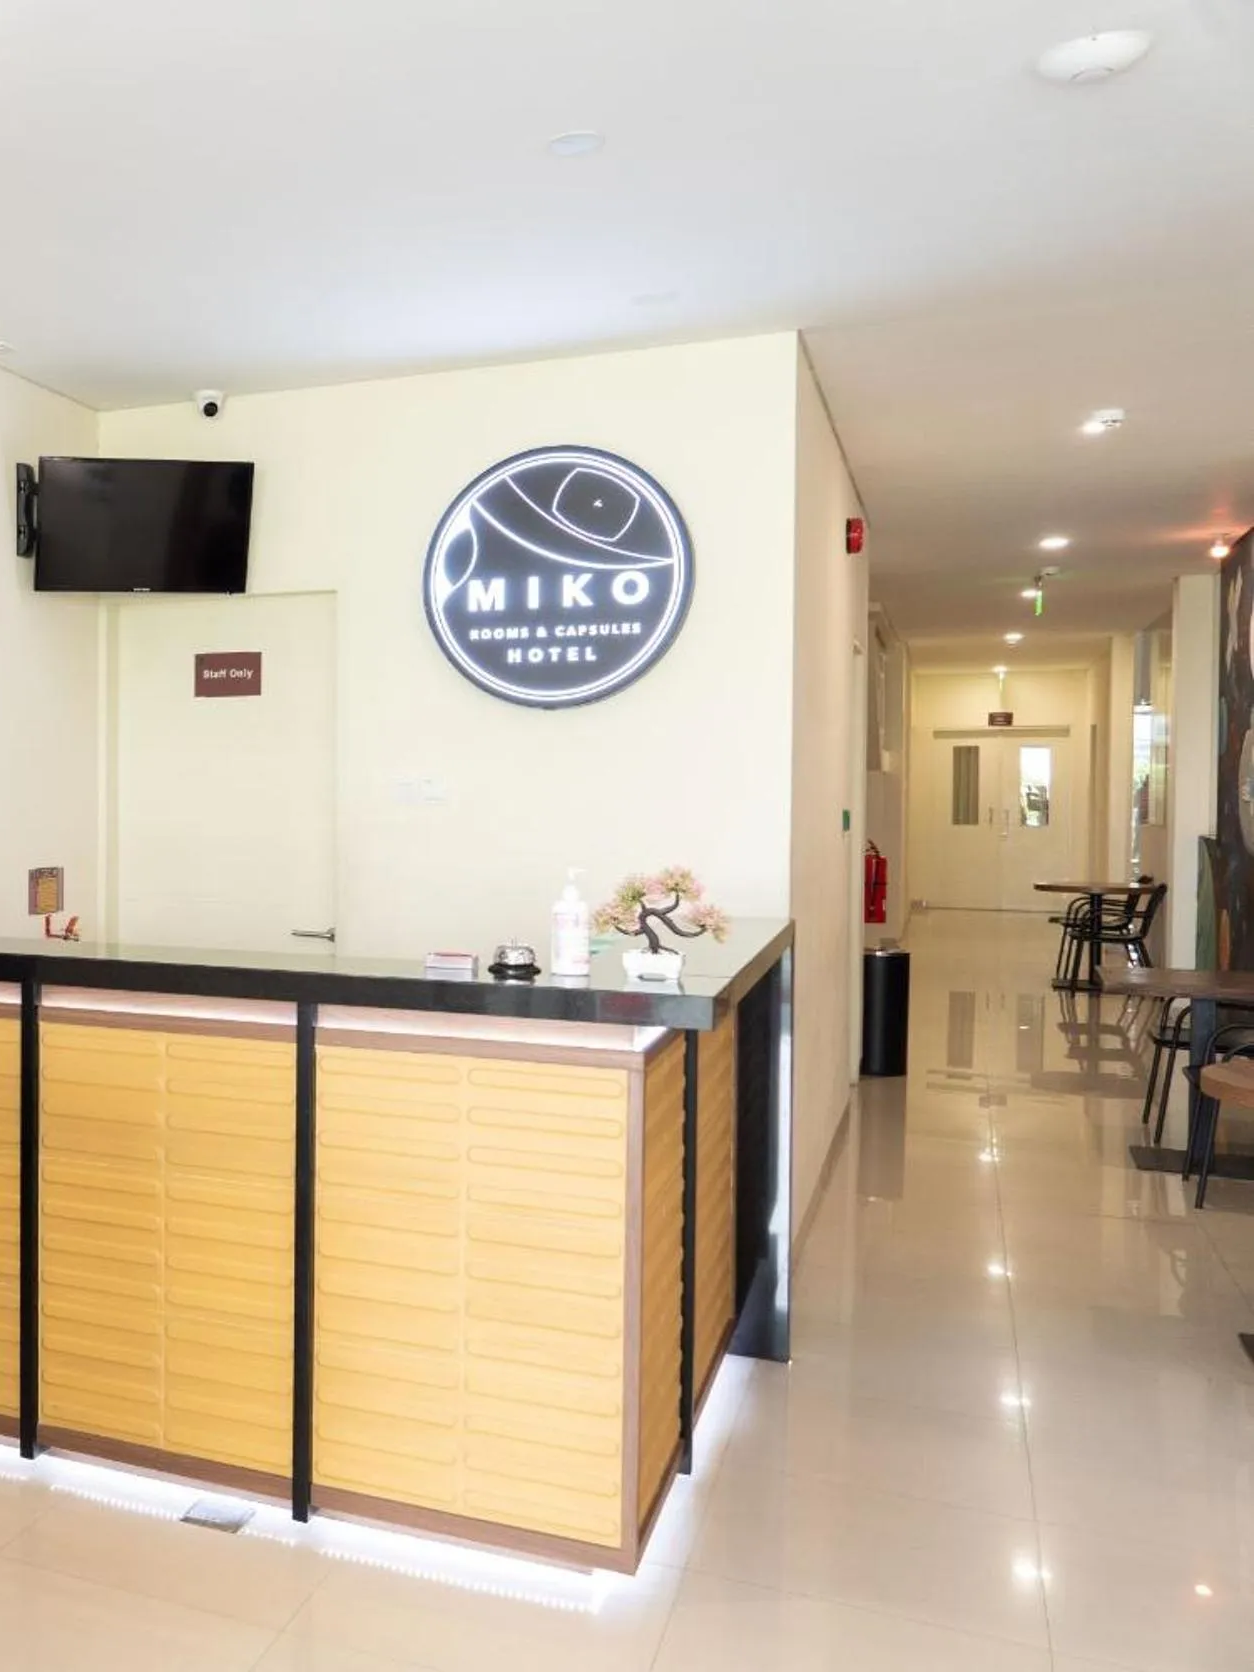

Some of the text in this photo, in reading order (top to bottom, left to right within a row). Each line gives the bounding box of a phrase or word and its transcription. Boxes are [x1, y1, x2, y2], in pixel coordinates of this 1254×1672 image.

[467, 570, 651, 613] MIKO
[469, 622, 642, 641] ROOMS & CAPSULES
[507, 647, 597, 664] HOTEL
[202, 667, 254, 680] Staff Only
